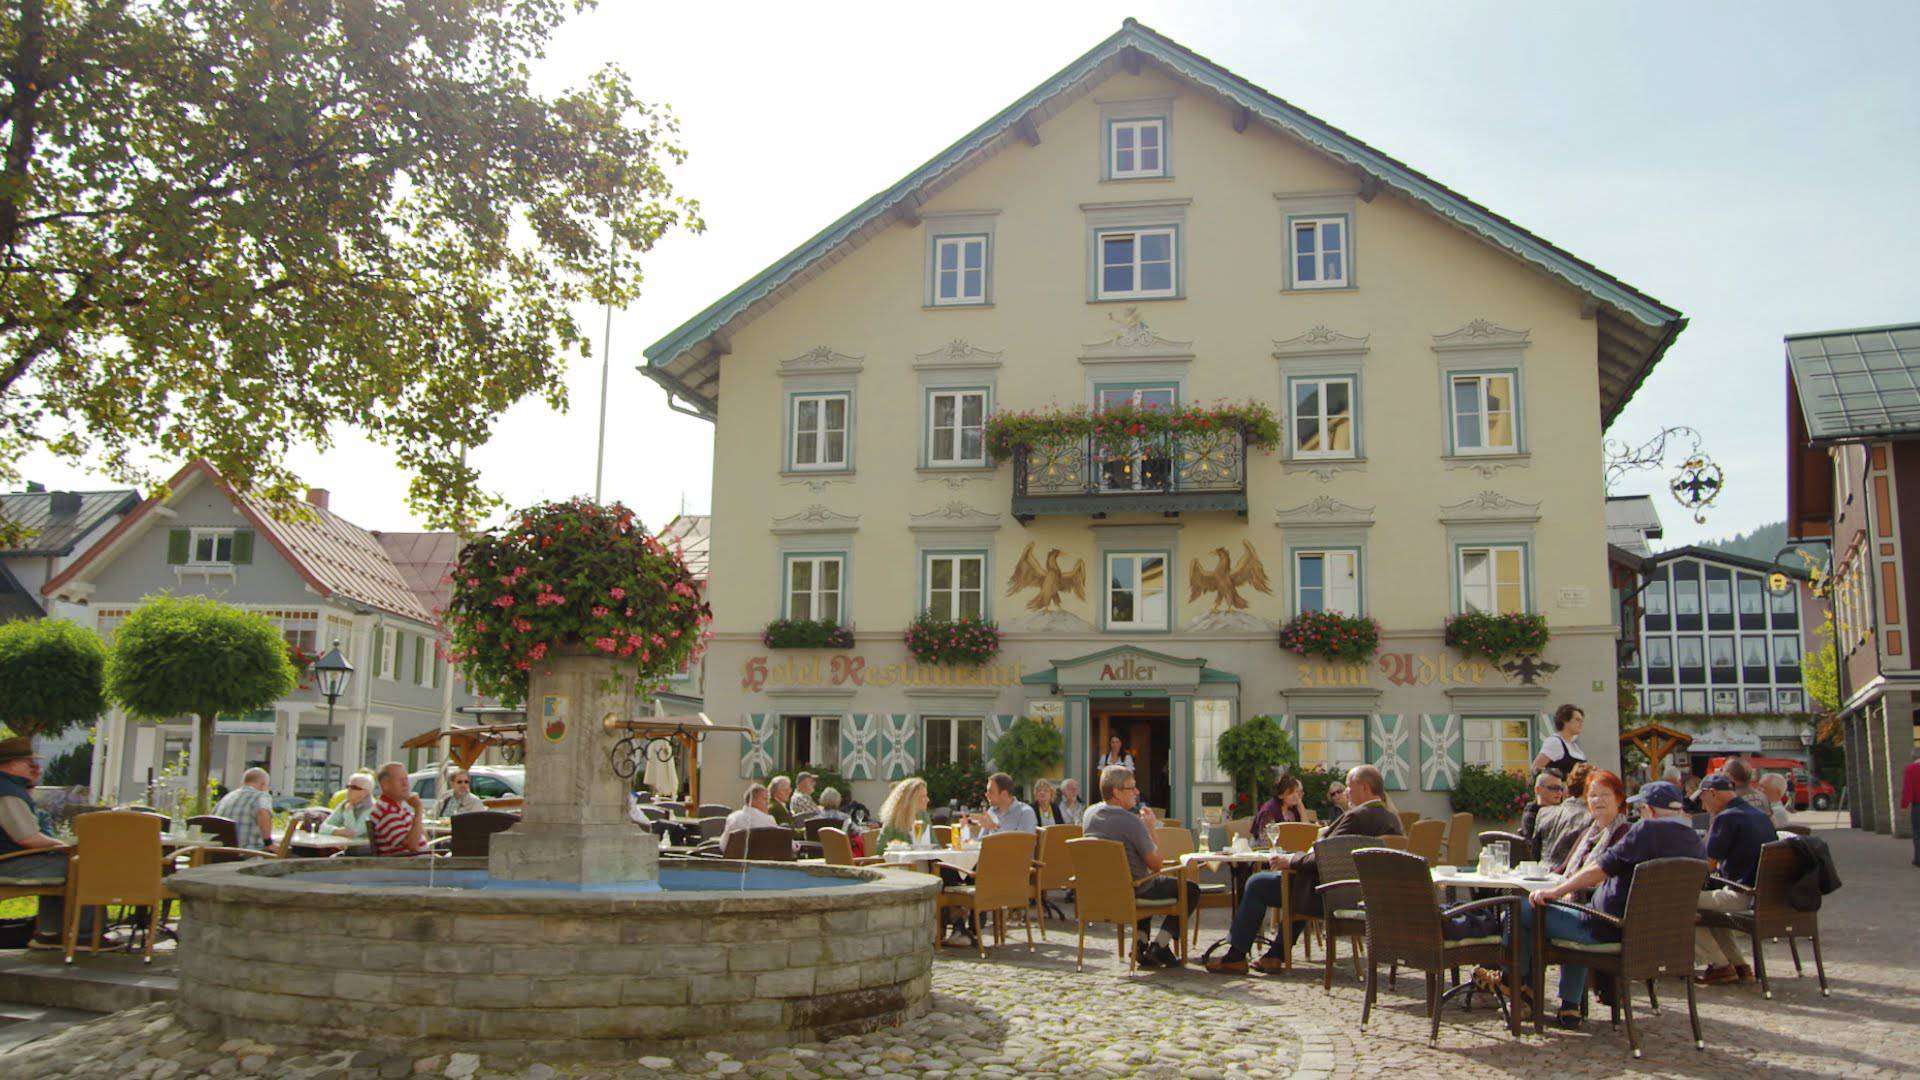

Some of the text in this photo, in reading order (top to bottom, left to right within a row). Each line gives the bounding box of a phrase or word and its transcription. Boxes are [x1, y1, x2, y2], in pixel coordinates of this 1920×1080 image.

[742, 655, 820, 692] Hotel
[1100, 658, 1157, 681] Adler
[1297, 653, 1487, 688] zum Adler
